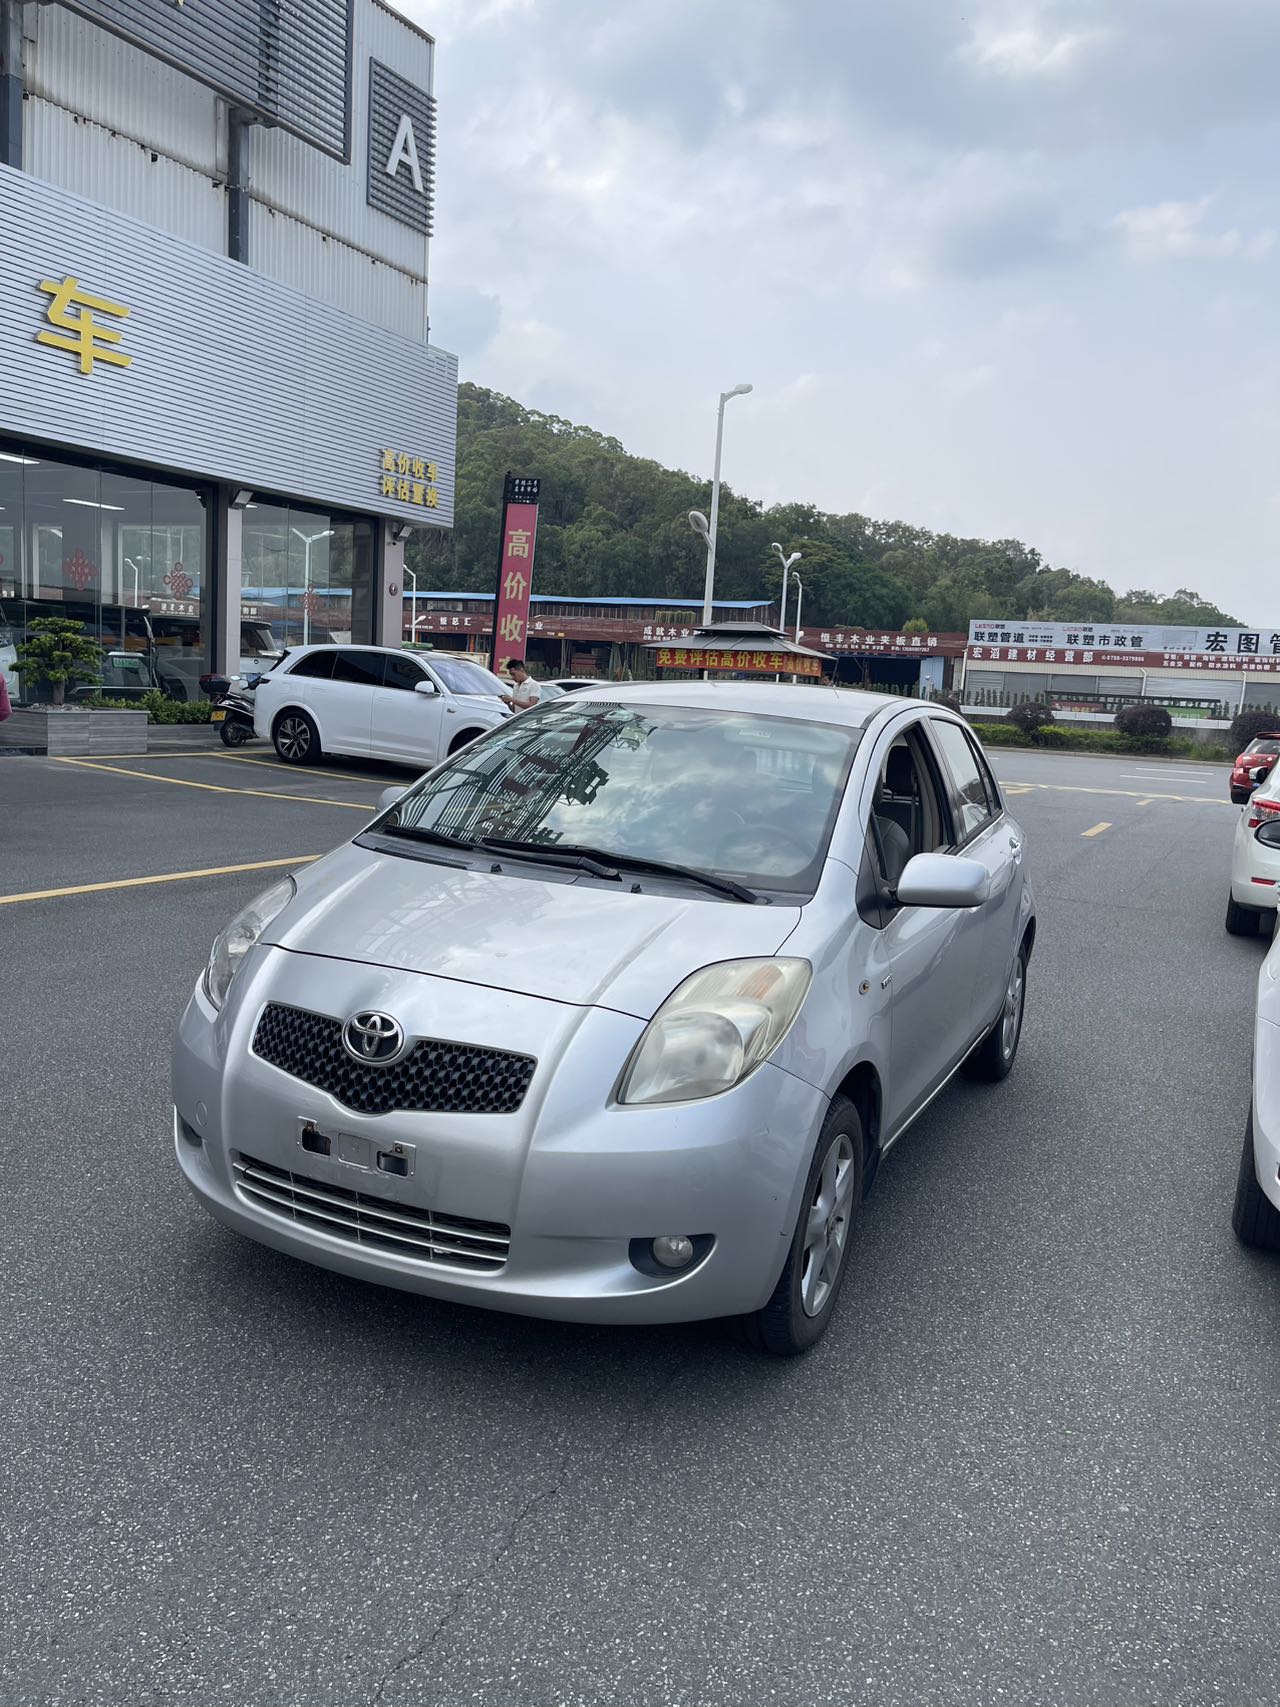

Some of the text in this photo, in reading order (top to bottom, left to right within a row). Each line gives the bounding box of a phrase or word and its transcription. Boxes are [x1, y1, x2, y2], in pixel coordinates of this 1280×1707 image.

[385, 114, 424, 193] A
[36, 276, 133, 375] 车
[381, 448, 437, 481] 高价收车
[381, 474, 437, 508] 评估置换
[820, 632, 937, 647] 恒丰木业夹板直销
[974, 631, 1025, 643] 联塑管道
[1066, 633, 1144, 648] 联塑市政管
[658, 649, 784, 669] 免费评估高价收车
[972, 647, 1095, 663] 宏滔建材经营部
